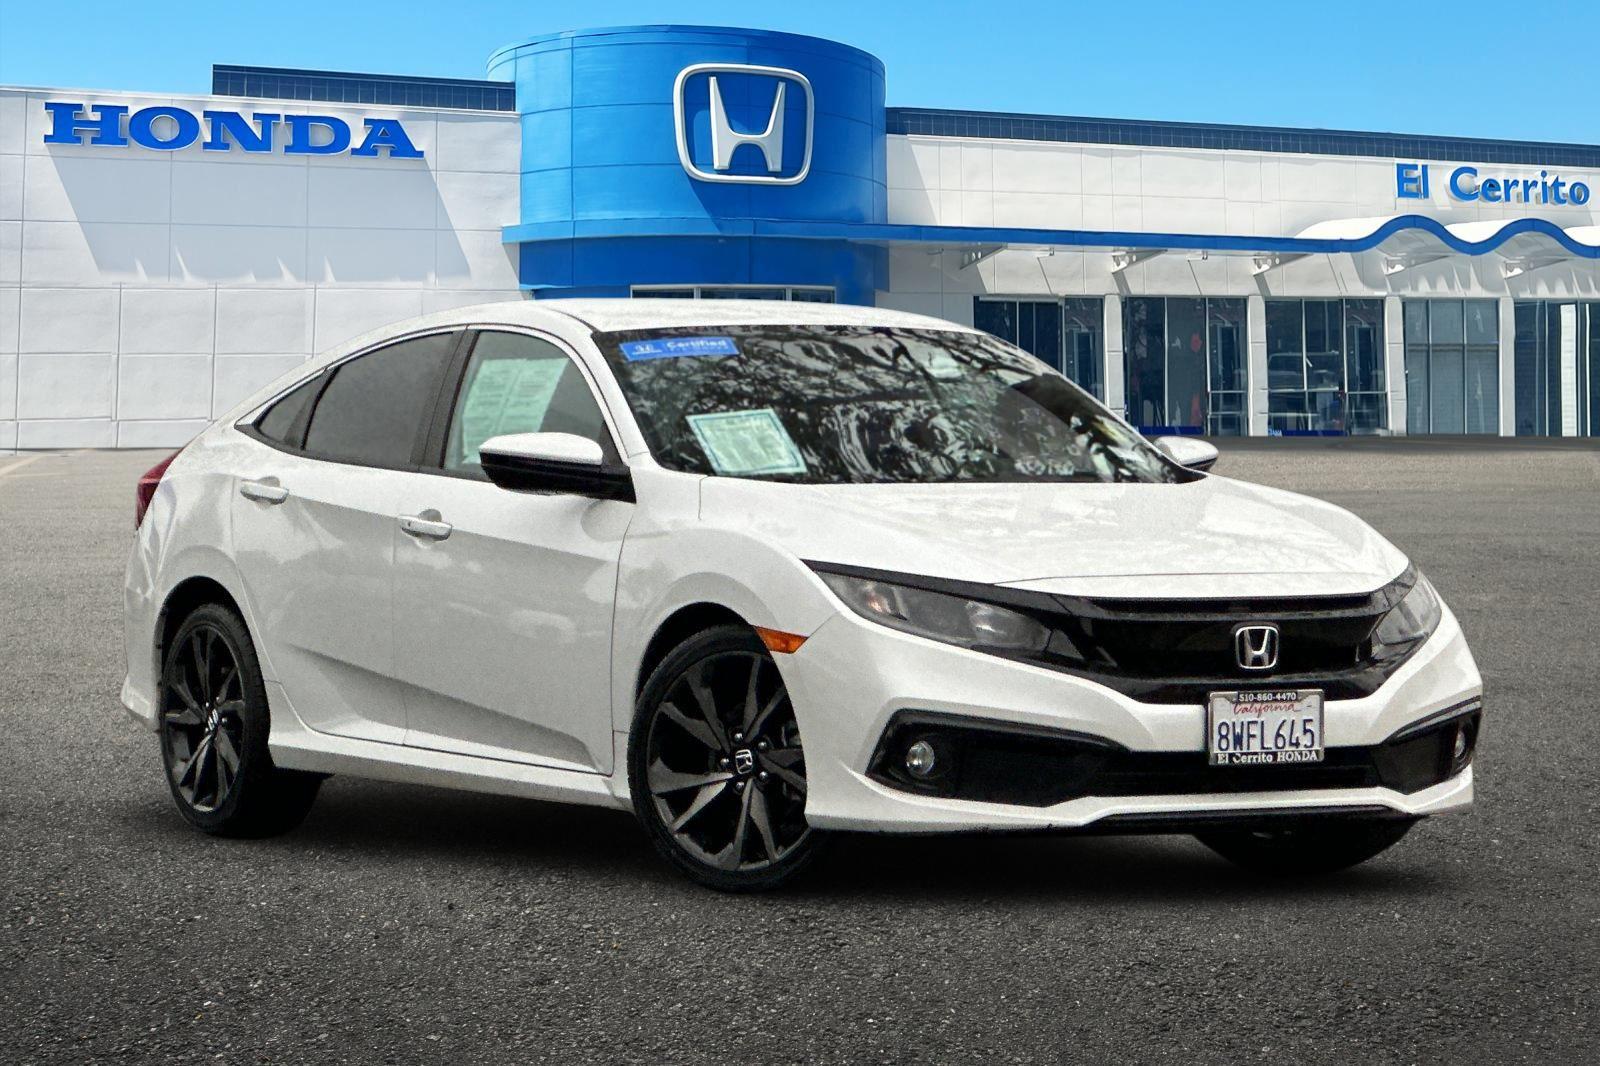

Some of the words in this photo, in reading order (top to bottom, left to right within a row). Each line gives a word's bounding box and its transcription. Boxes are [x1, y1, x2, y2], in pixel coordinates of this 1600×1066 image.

[44, 101, 425, 158] HONDA
[1395, 163, 1430, 199] El
[1449, 166, 1590, 206] Cerrito
[1233, 702, 1300, 718] California
[1217, 719, 1315, 752] 8WFL645
[1217, 754, 1229, 764] El
[1233, 753, 1273, 763] Cerrito
[1277, 751, 1319, 763] HONDA
